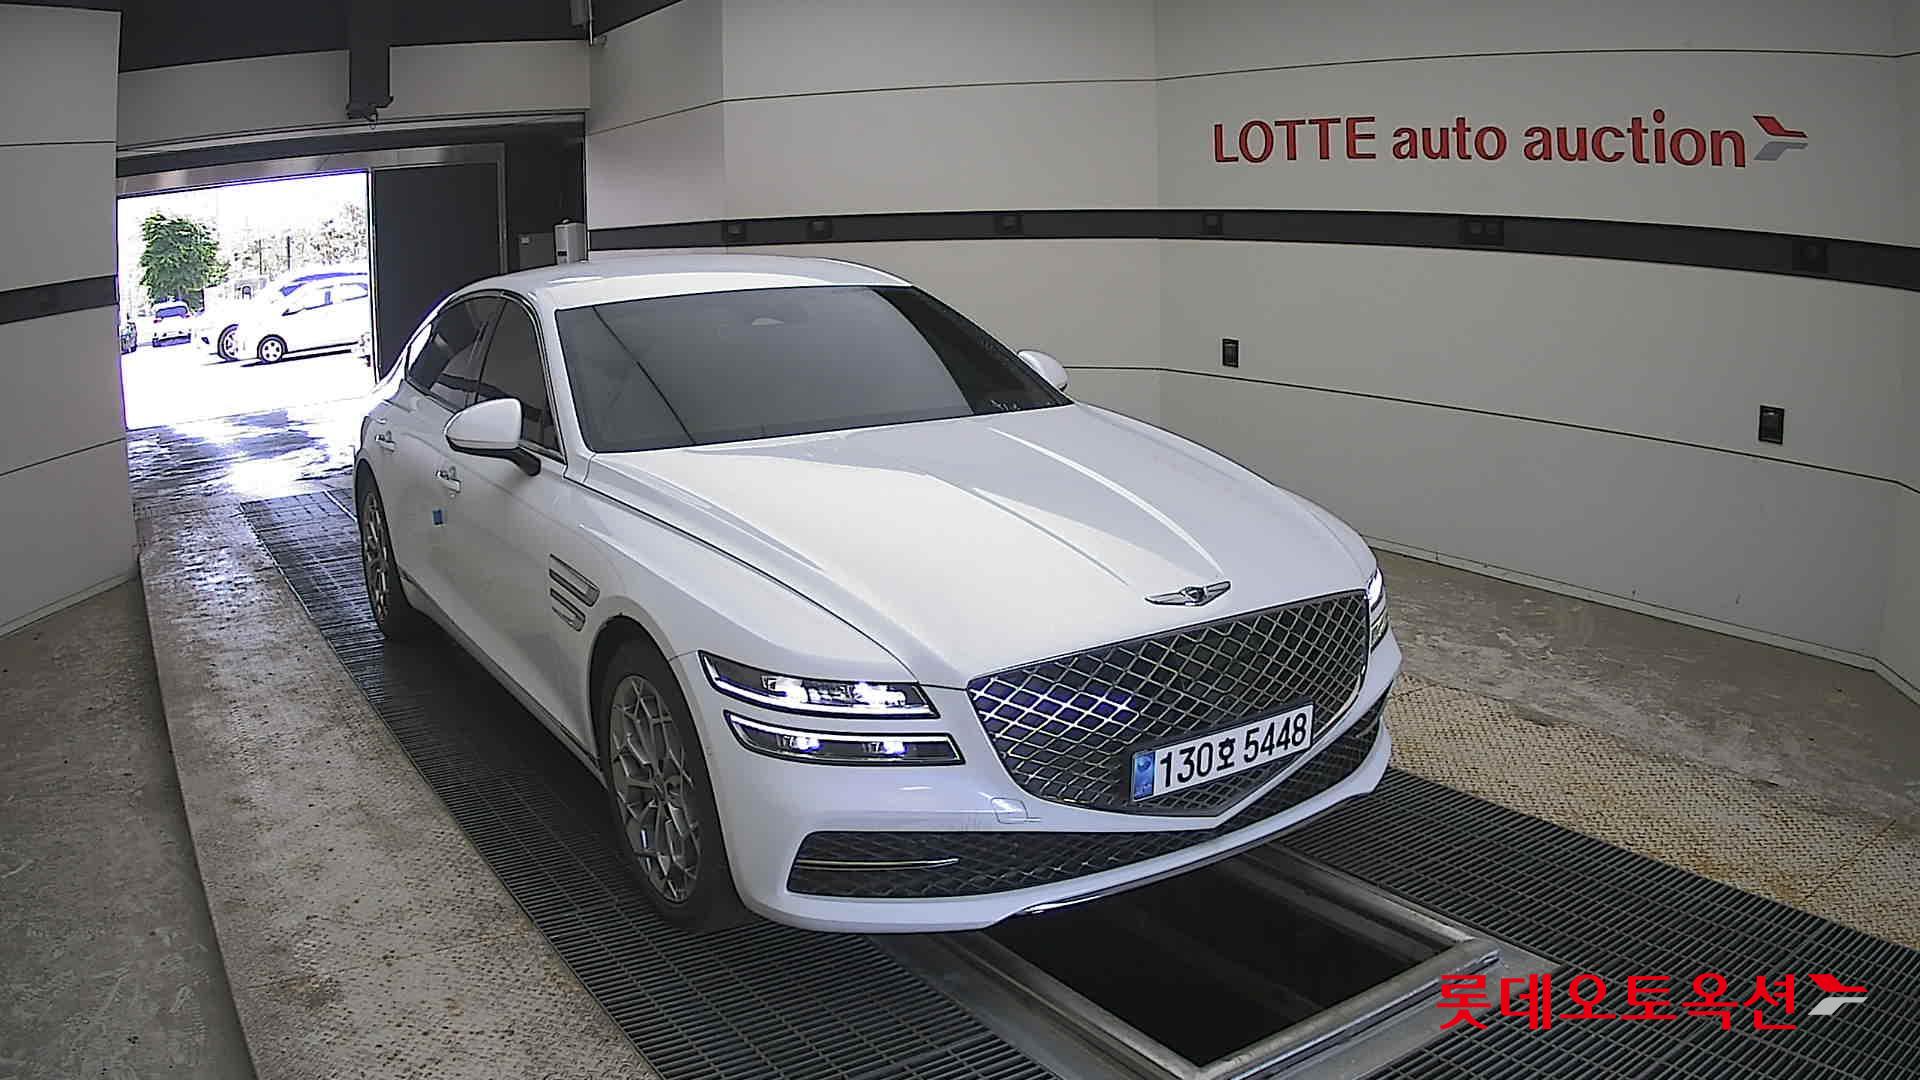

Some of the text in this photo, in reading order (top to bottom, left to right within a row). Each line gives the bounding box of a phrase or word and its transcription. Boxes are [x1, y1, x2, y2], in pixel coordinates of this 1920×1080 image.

[1213, 108, 1746, 169] LOTTE auto auction
[1160, 713, 1307, 787] 130호 5448
